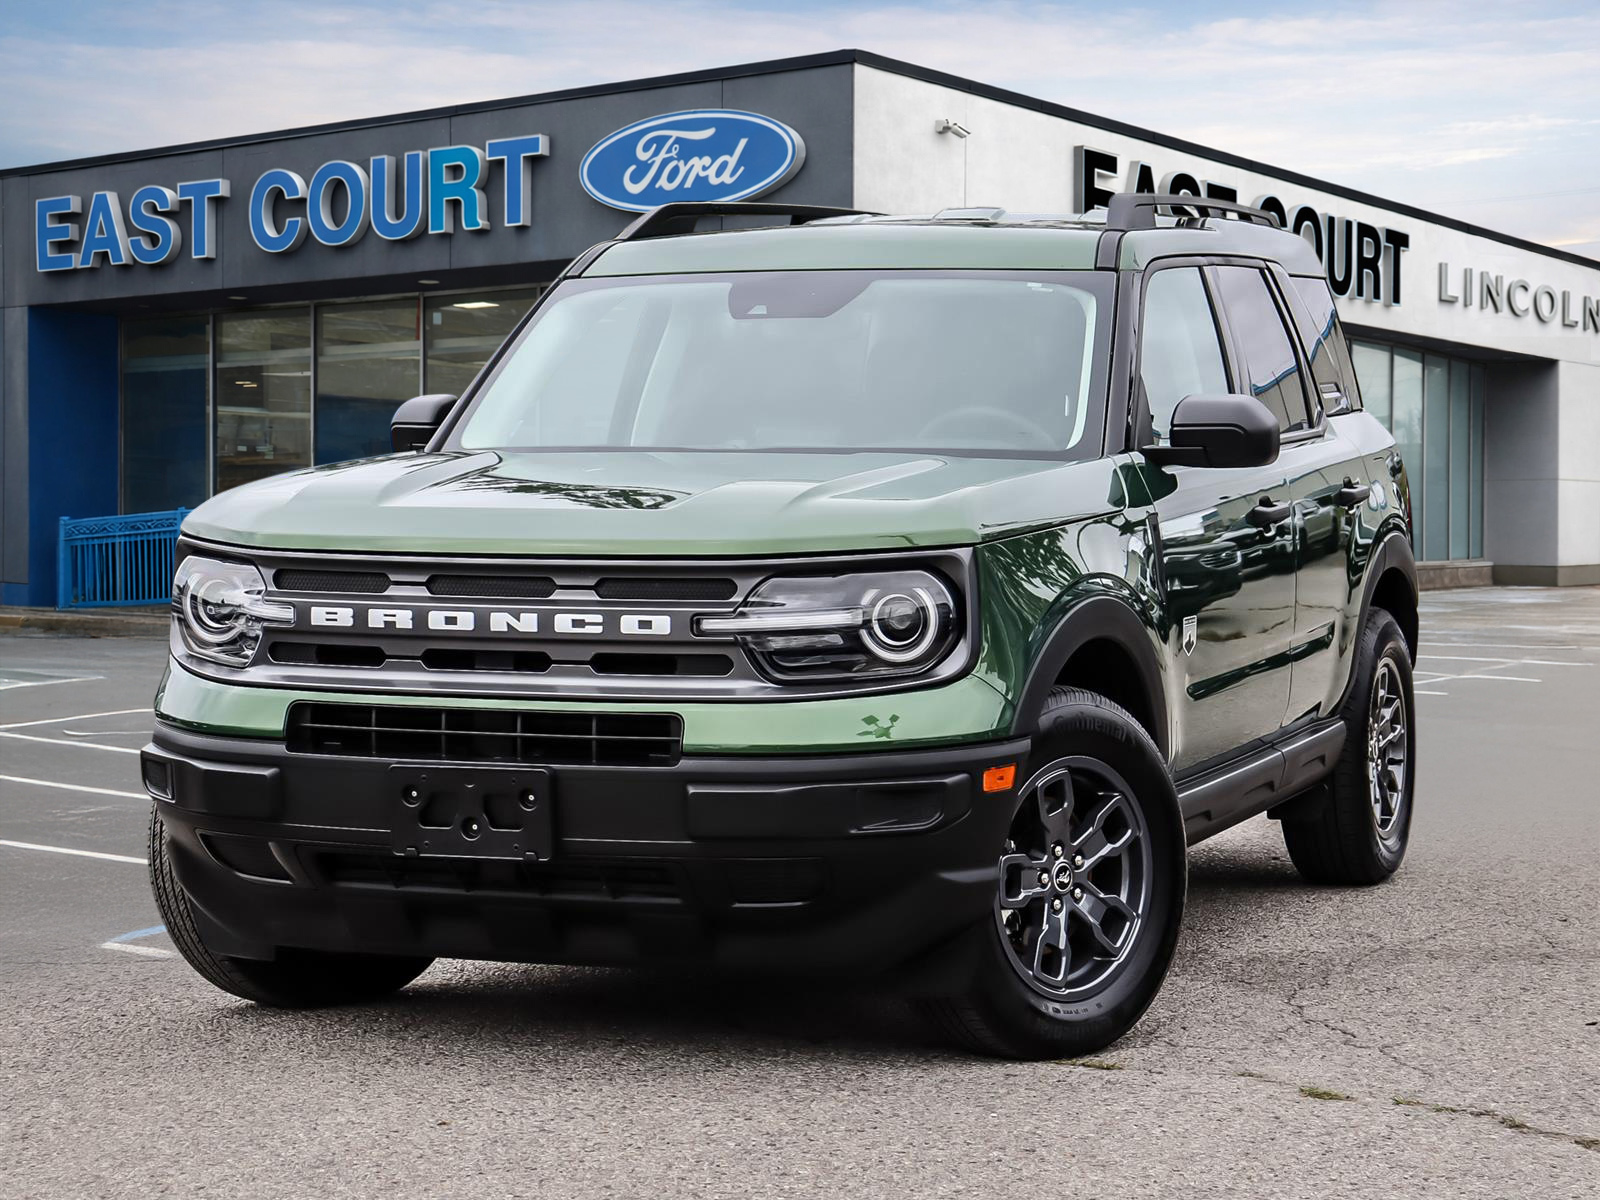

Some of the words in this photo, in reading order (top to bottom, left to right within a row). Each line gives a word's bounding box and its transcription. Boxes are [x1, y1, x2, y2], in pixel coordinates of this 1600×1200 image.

[623, 127, 749, 195] Ford
[36, 178, 230, 272] EAST
[249, 134, 549, 253] COURT
[1438, 262, 1600, 334] LINCOLN
[310, 606, 672, 636] BRONCO
